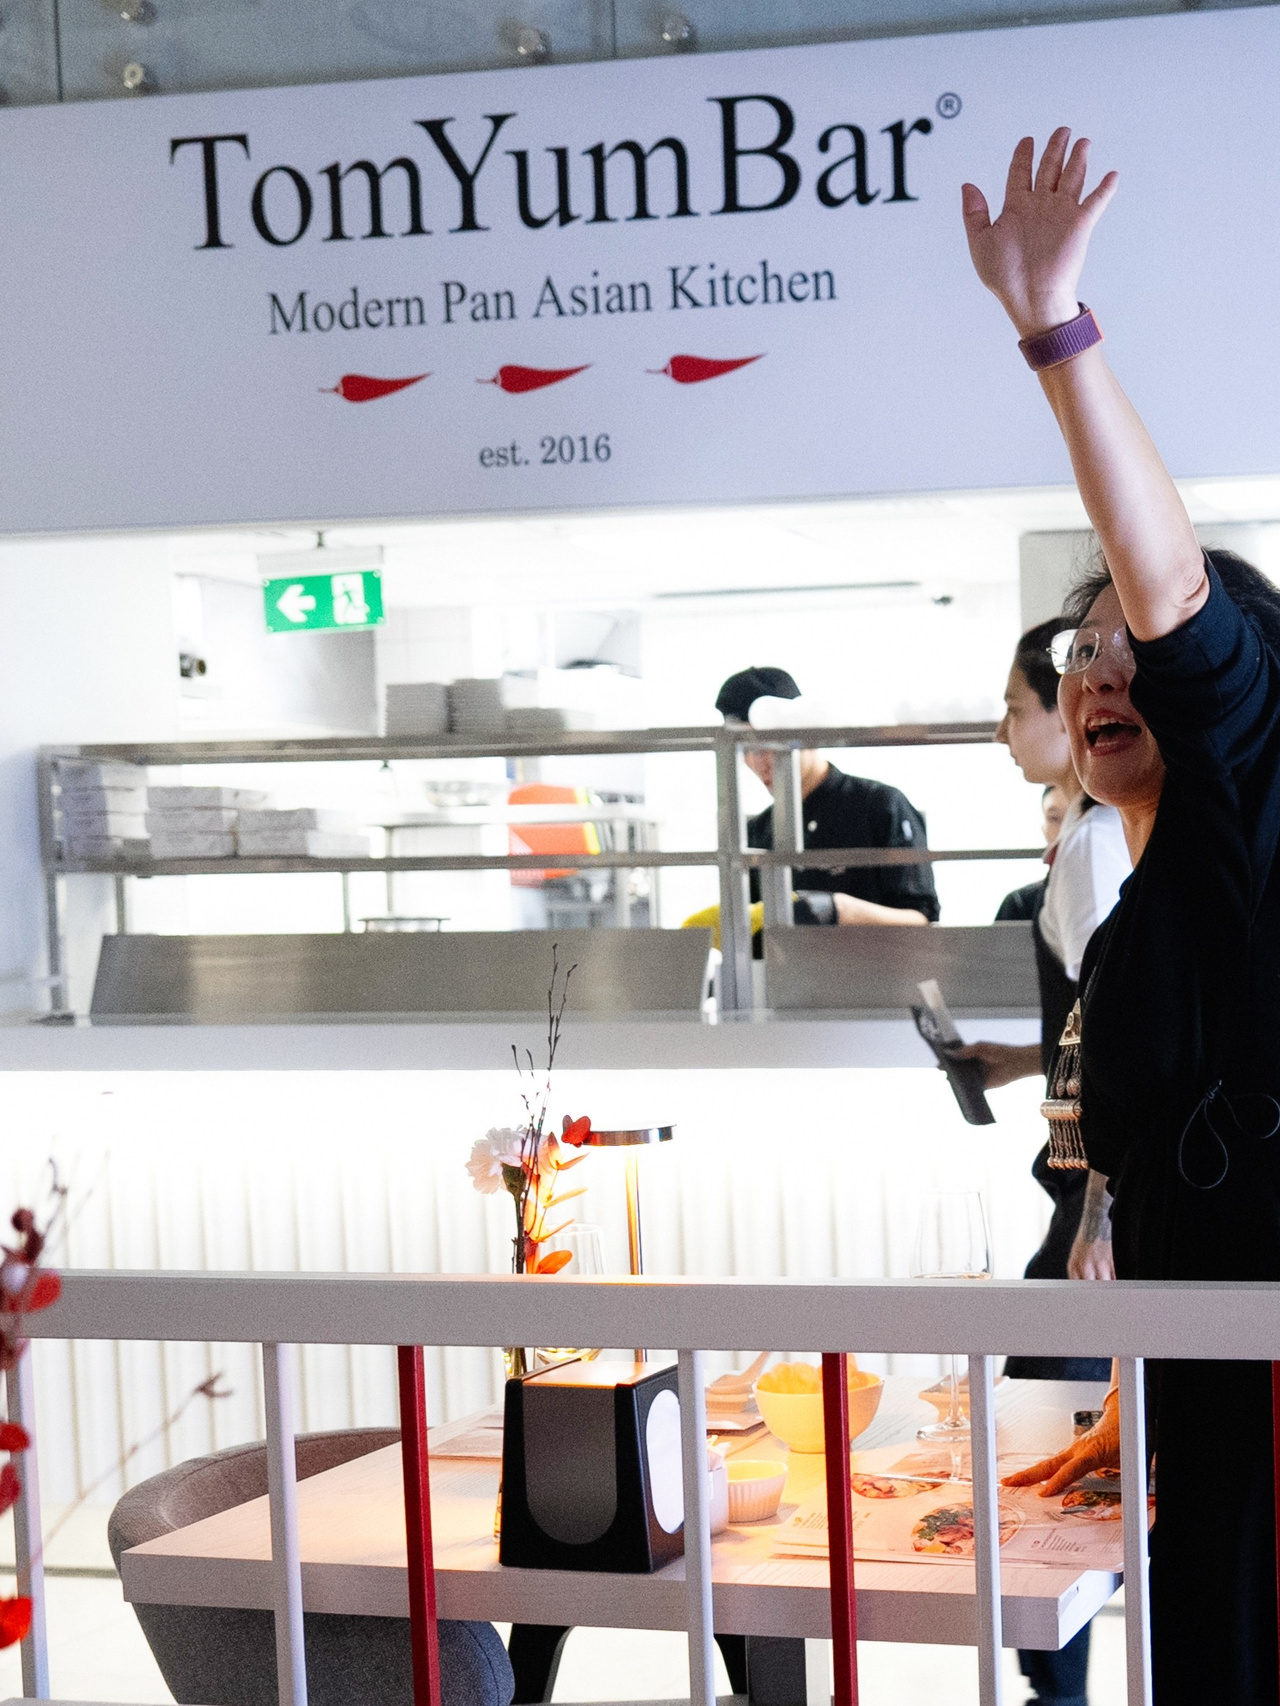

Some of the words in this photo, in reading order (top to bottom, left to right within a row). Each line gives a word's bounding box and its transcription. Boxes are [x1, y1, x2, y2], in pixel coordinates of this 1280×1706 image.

[268, 286, 427, 336] Modern
[441, 280, 517, 325] Pan
[532, 270, 653, 319] Asian
[668, 259, 838, 311] Kitchen
[478, 442, 531, 468] est.
[539, 434, 613, 466] 2016
